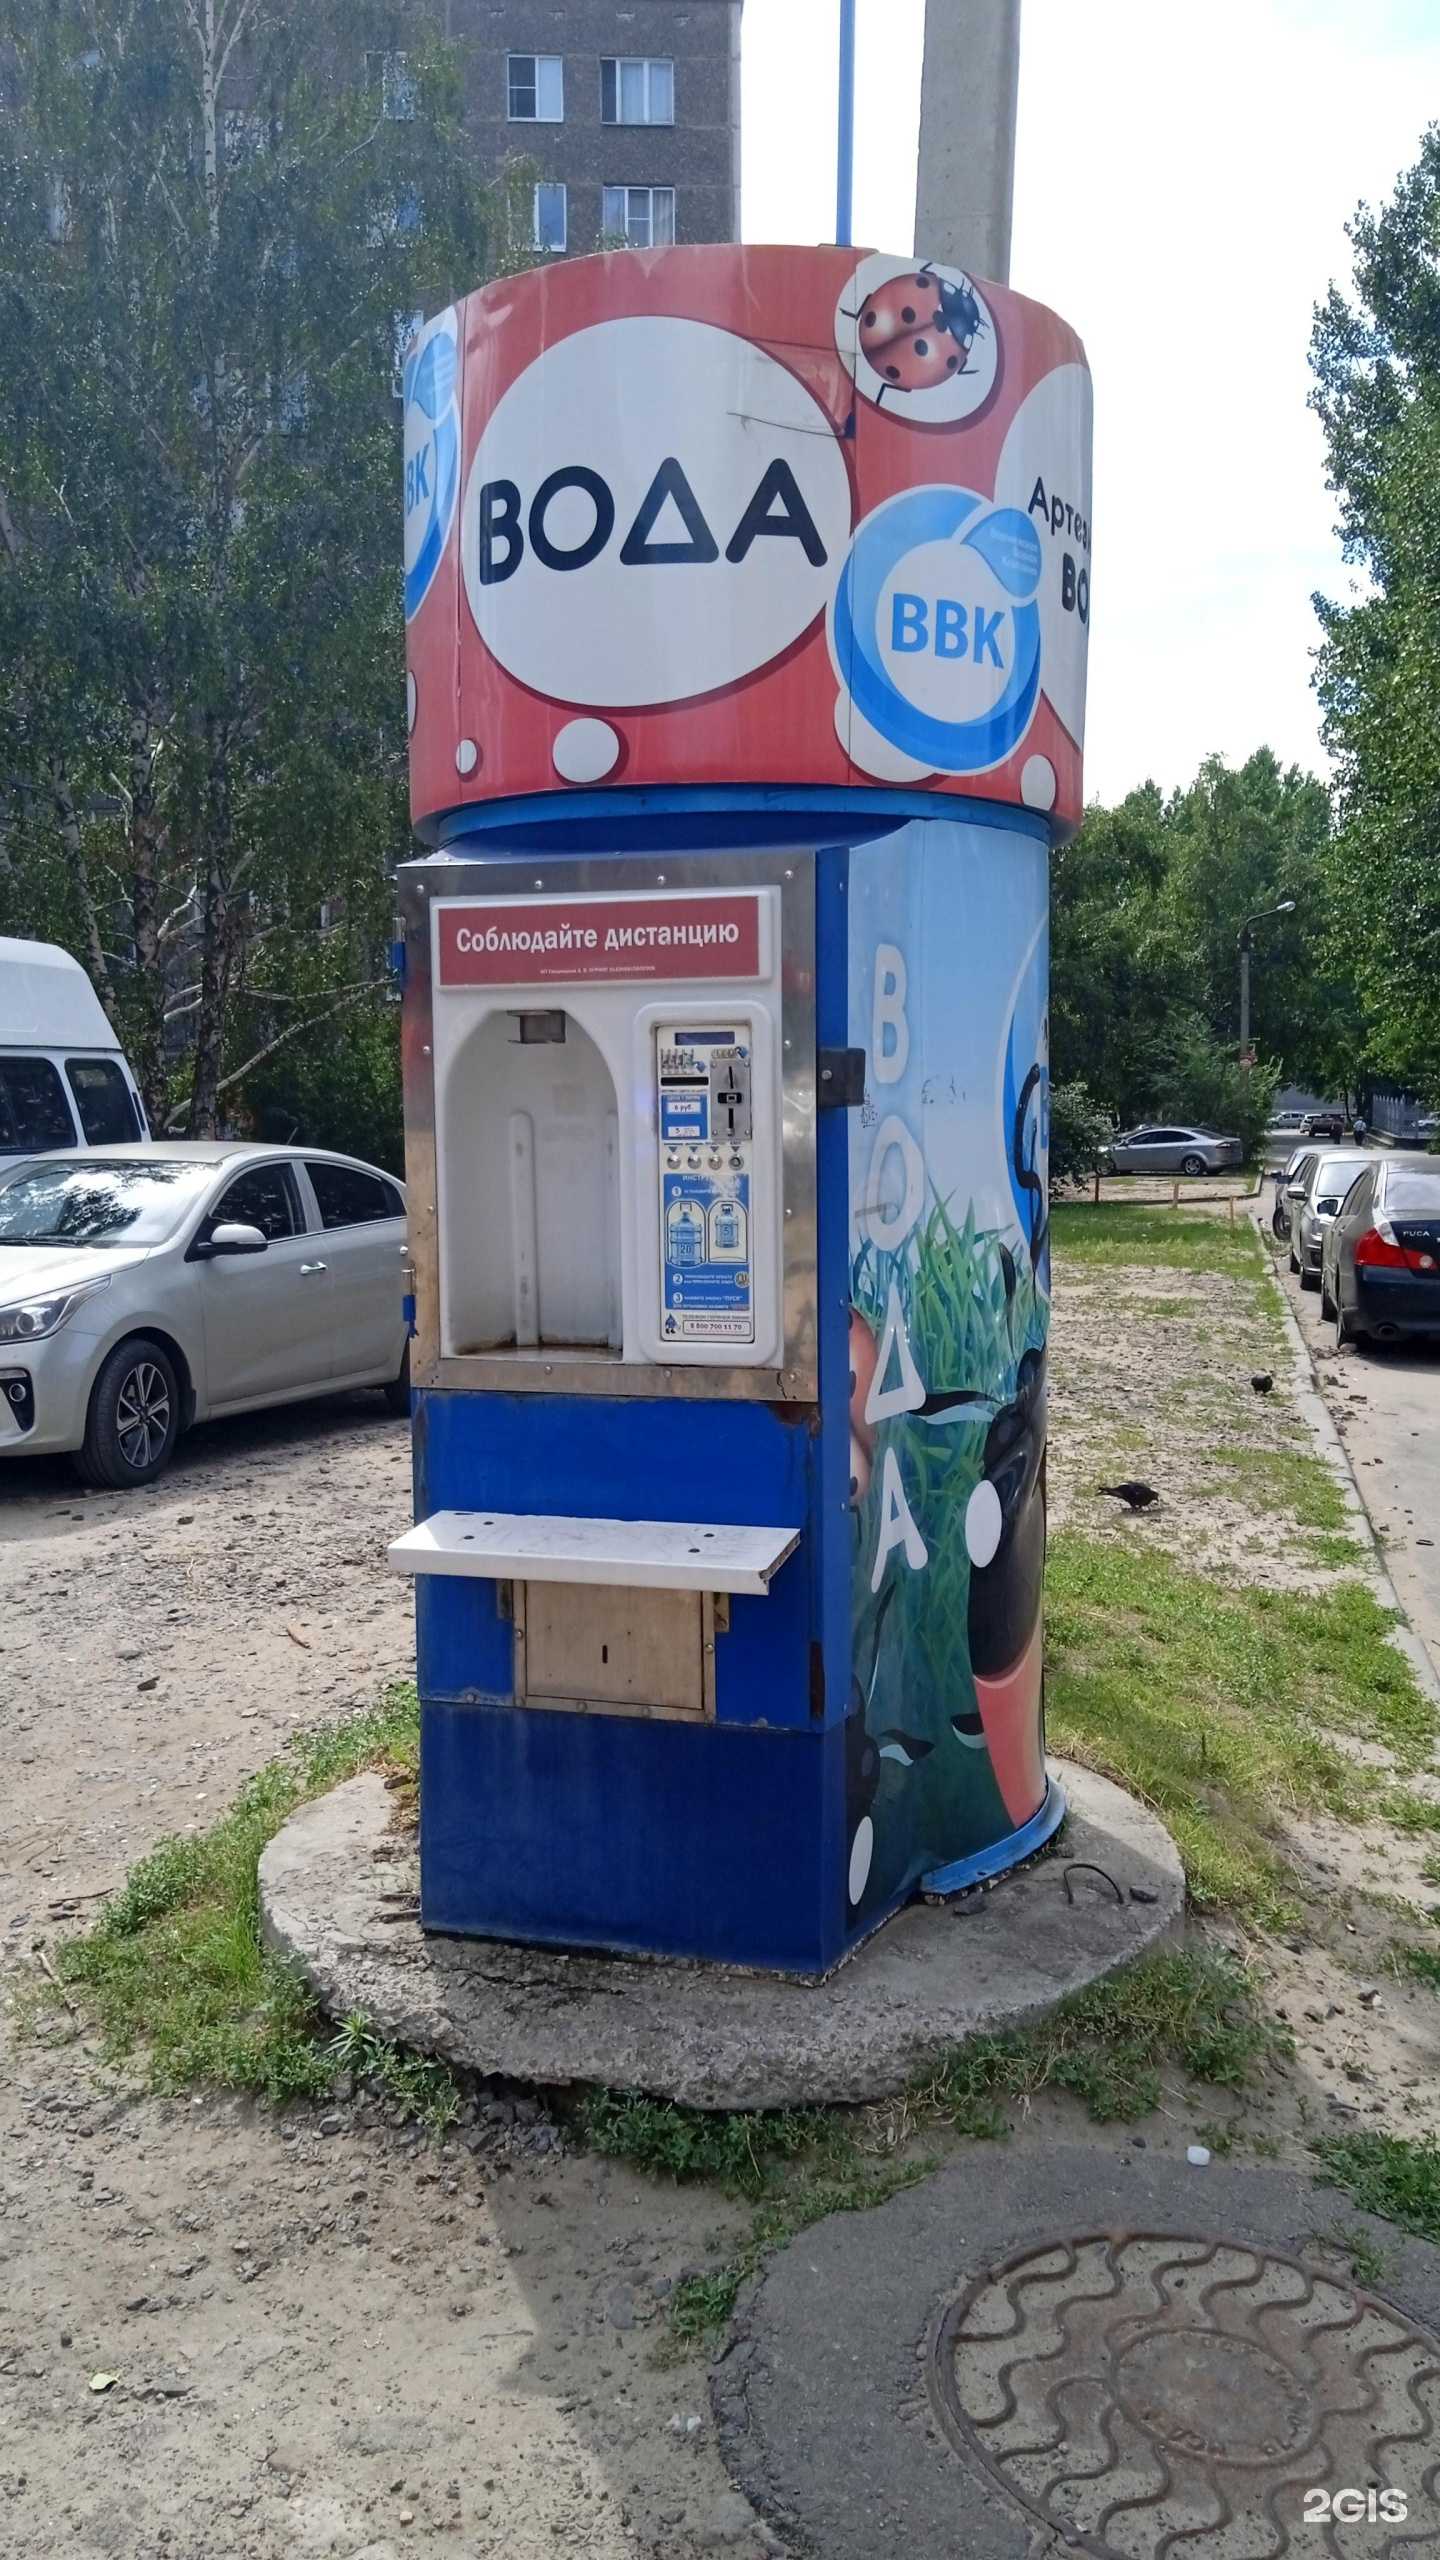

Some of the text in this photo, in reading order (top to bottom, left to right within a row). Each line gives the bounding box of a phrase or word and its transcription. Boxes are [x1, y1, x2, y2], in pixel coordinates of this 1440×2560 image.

[480, 457, 828, 585] ВОДА
[1028, 476, 1090, 553] Артез
[892, 593, 1005, 669] ВВК
[456, 923, 740, 953] Соблюдайте дистанцию
